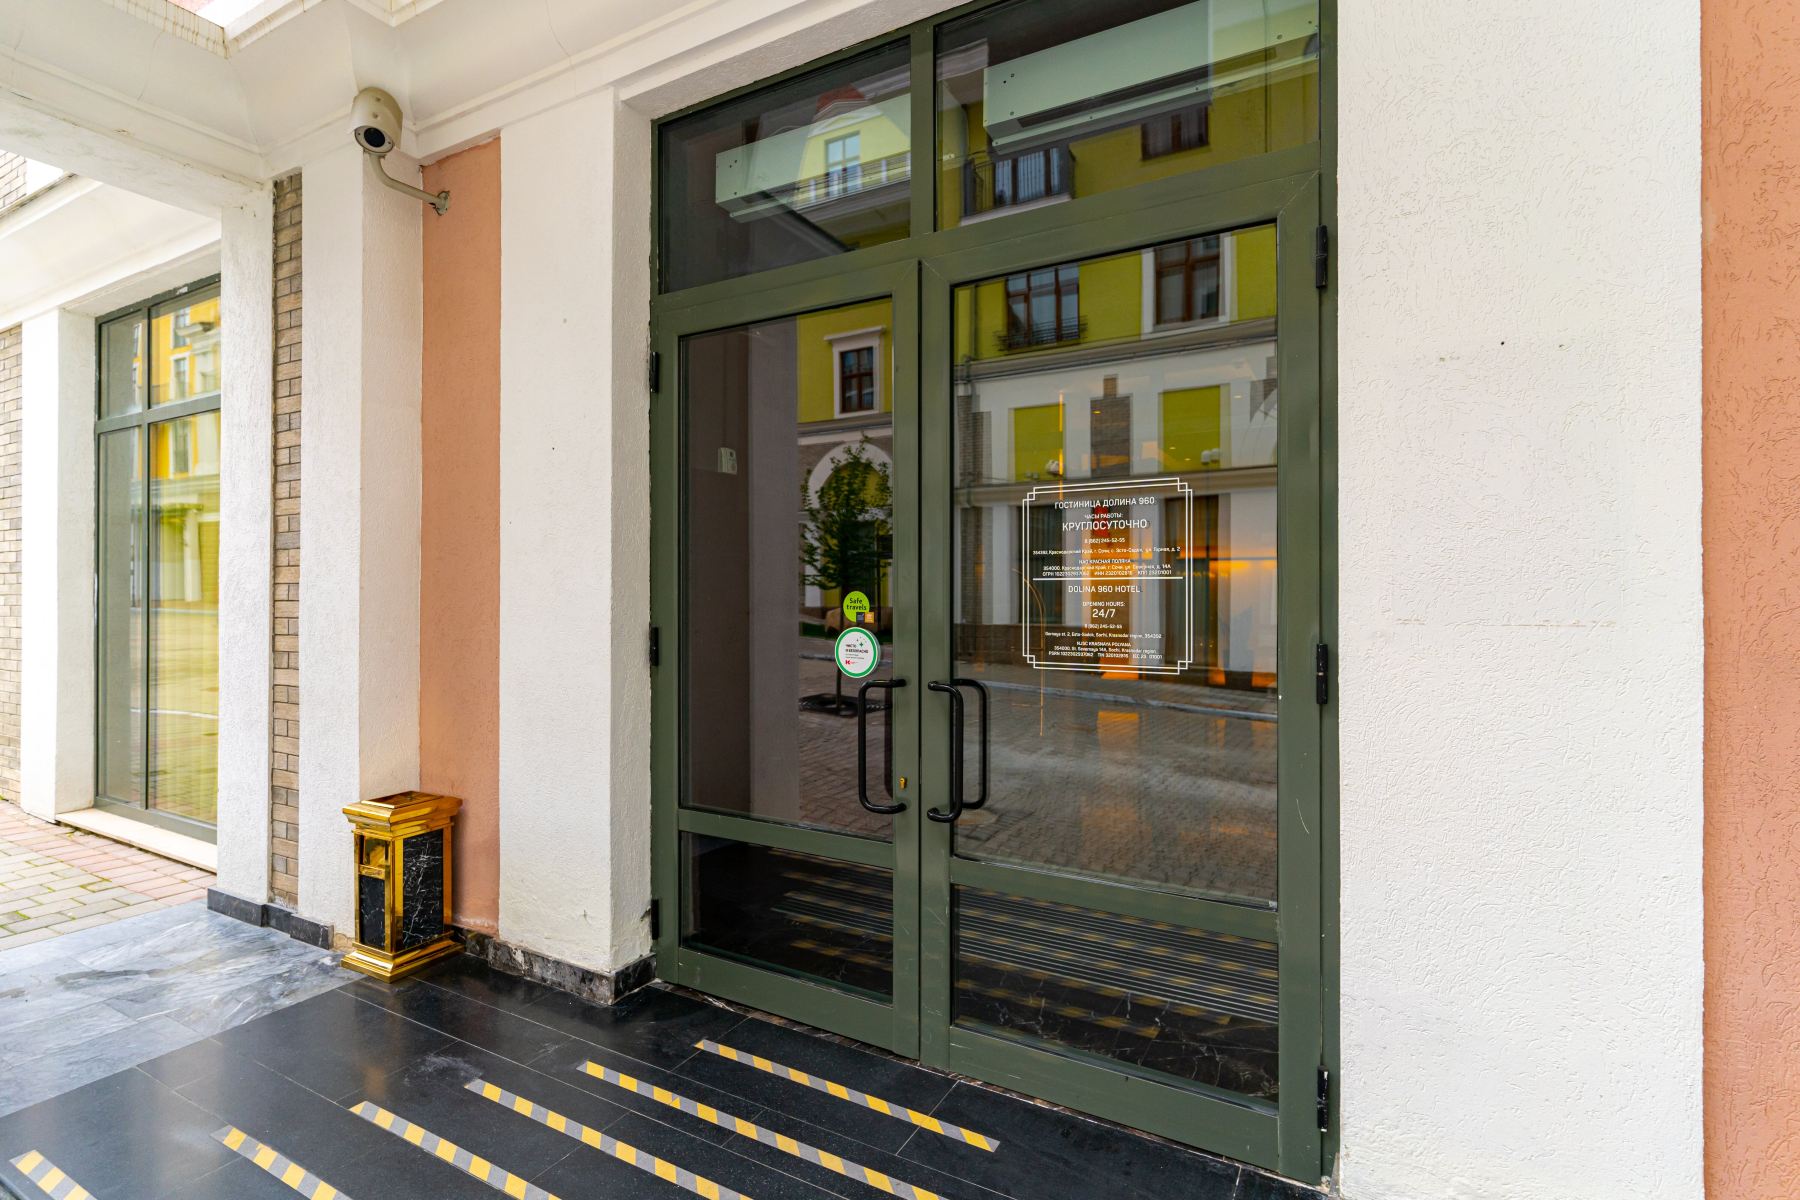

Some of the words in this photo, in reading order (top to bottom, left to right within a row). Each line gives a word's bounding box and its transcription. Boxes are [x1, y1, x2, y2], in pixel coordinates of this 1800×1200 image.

[1054, 499, 1101, 510] ГОСТИНИЦА
[1103, 498, 1137, 508] ДОЛИНА
[1138, 496, 1155, 505] 960
[1062, 518, 1148, 532] КРУГЛОСУТОЧНО
[1092, 608, 1116, 618] 24/7
